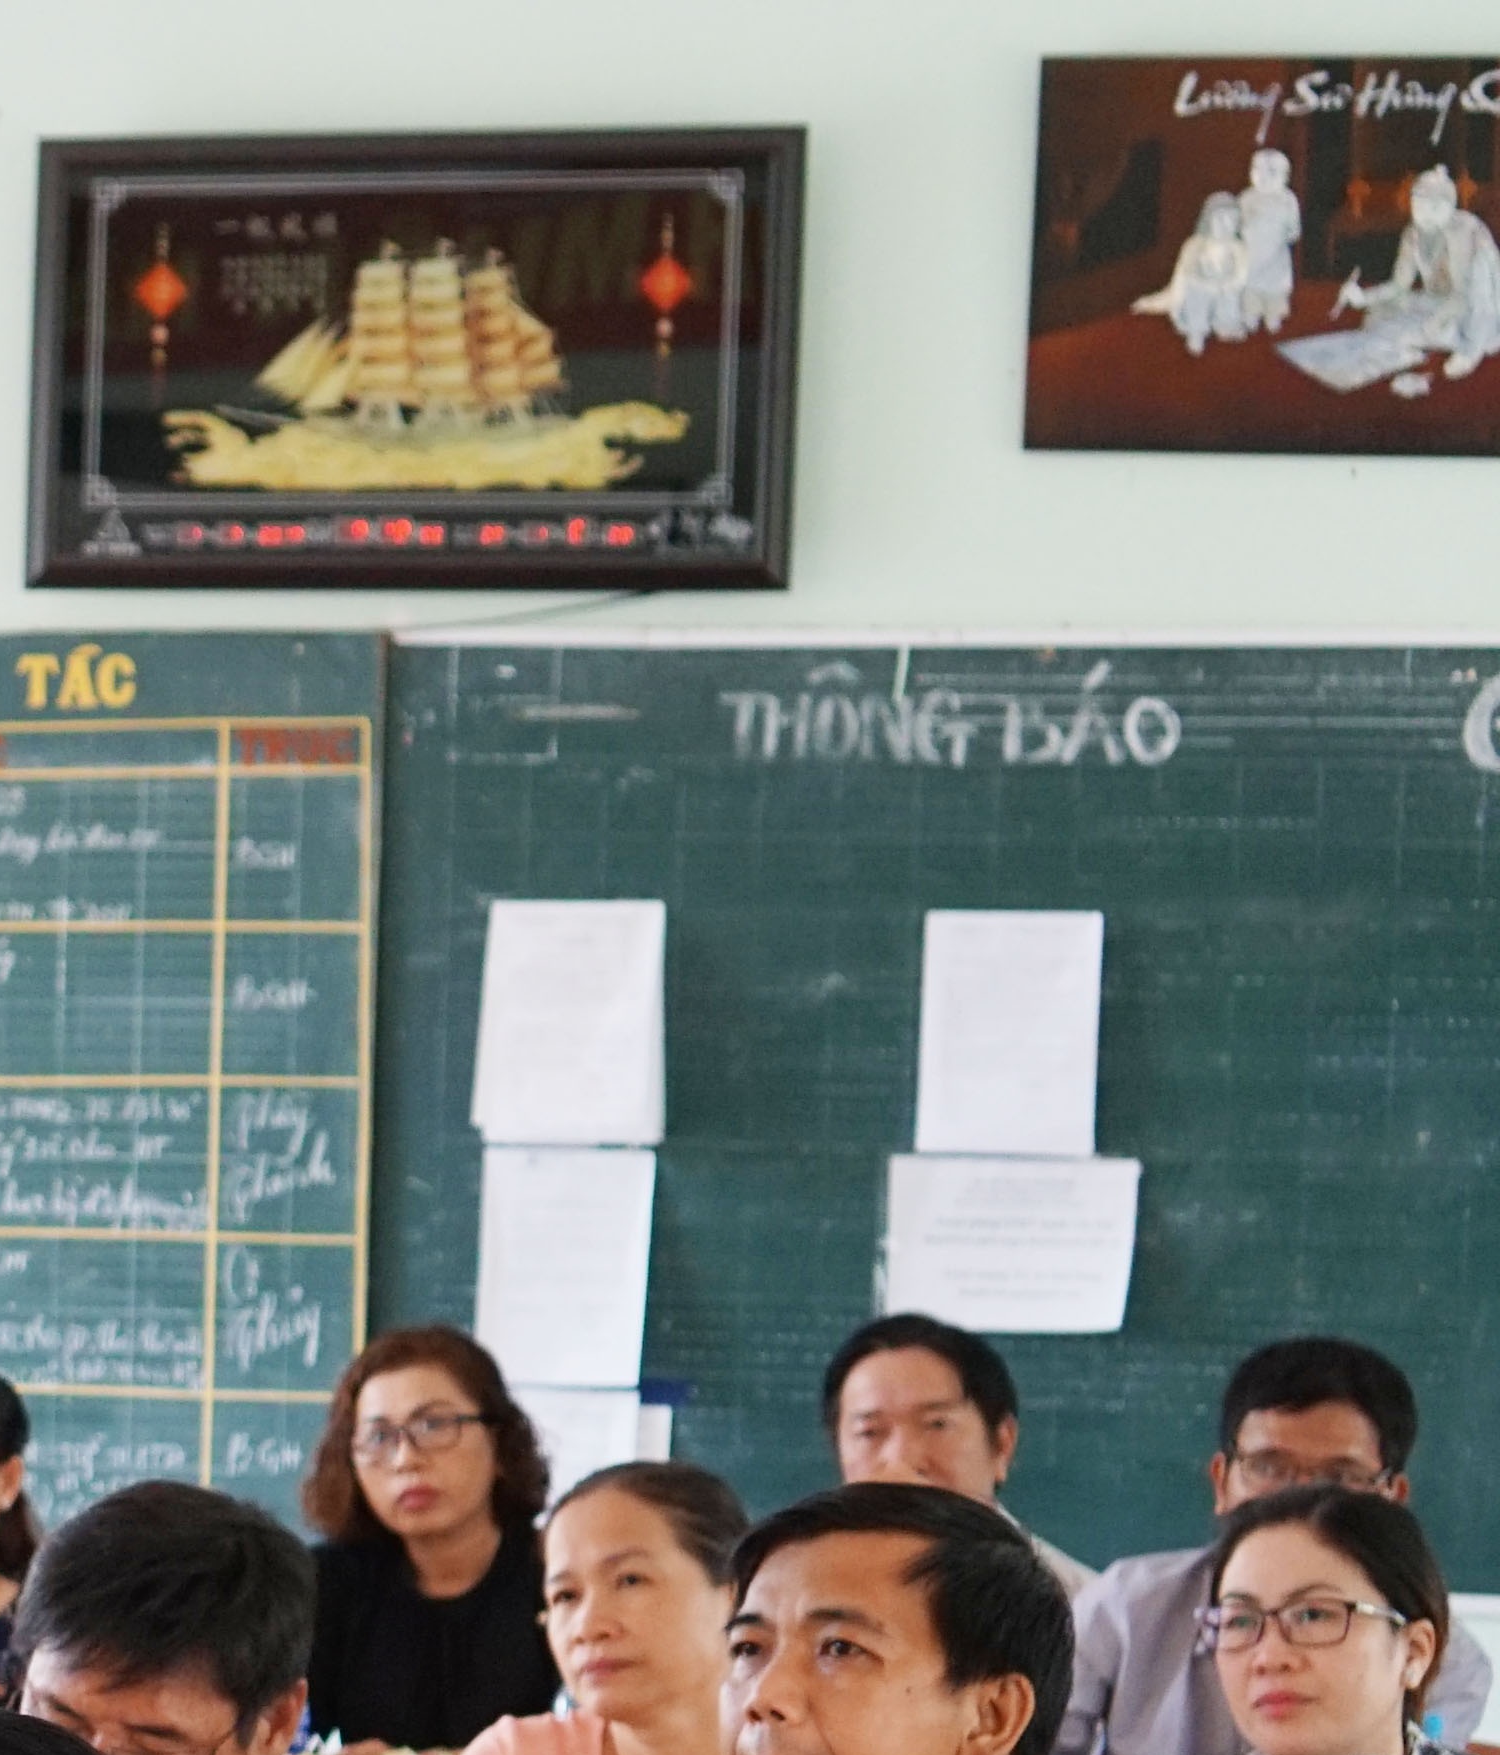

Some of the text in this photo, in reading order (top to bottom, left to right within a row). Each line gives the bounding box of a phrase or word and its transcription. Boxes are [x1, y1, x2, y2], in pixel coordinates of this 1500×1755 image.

[17, 643, 137, 711] TÁC
[718, 658, 1184, 768] THÔNG BÁO
